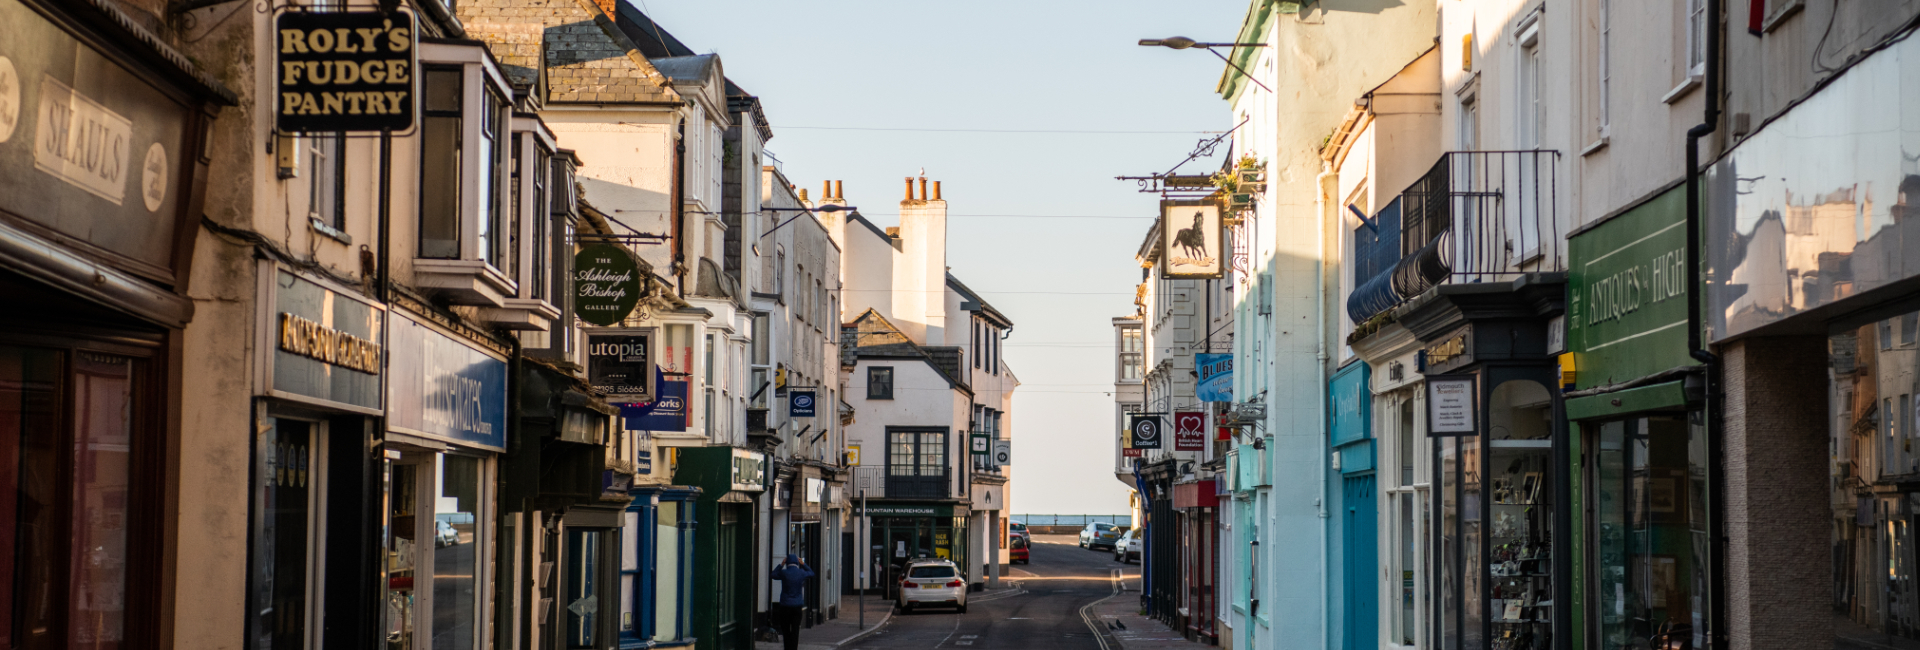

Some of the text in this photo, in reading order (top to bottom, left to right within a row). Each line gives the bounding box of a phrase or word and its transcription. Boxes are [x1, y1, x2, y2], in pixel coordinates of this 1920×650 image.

[280, 18, 410, 54] ROLY'S
[282, 59, 409, 85] FUDGE
[282, 91, 407, 115] PANTRY
[46, 100, 123, 183] SHAULS
[574, 267, 631, 287] Ashleigh
[1589, 265, 1640, 324] ANTIQUES
[1652, 247, 1685, 303] HIGH
[579, 282, 626, 302] Bishop
[589, 339, 645, 362] utopia
[1202, 359, 1233, 380] BLUES
[422, 339, 482, 434] Housewares
[617, 385, 644, 393] 516666
